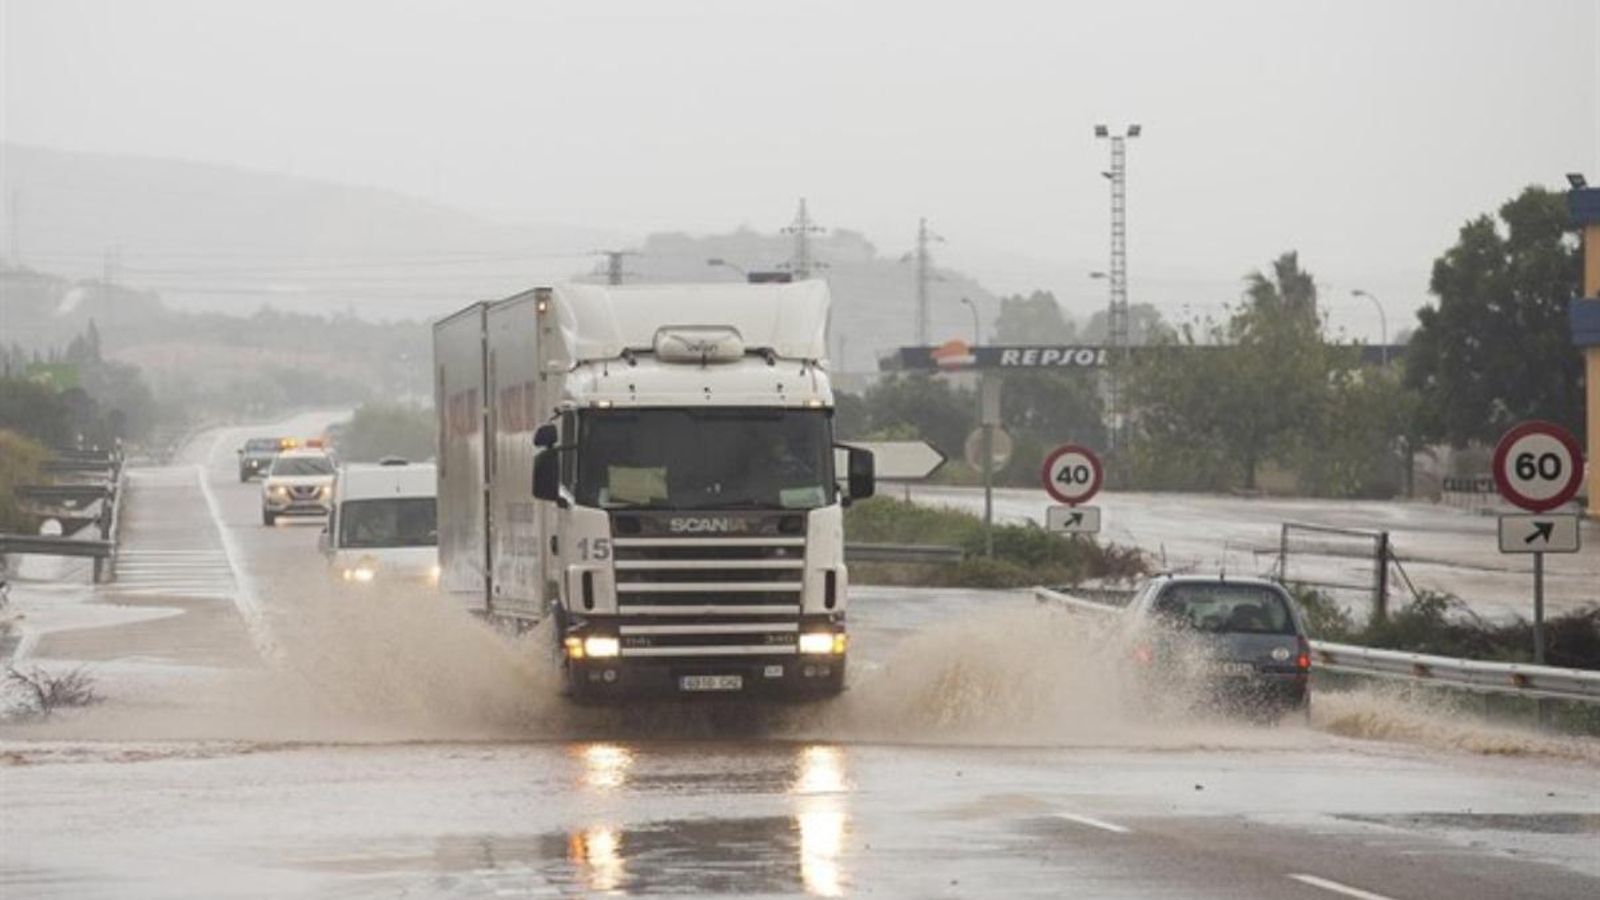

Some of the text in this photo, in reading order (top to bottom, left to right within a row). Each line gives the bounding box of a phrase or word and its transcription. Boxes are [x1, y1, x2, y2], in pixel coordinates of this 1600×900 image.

[1001, 348, 1108, 366] REPSOL
[1056, 464, 1090, 485] 40
[1515, 452, 1562, 481] 60
[577, 538, 610, 560] 15
